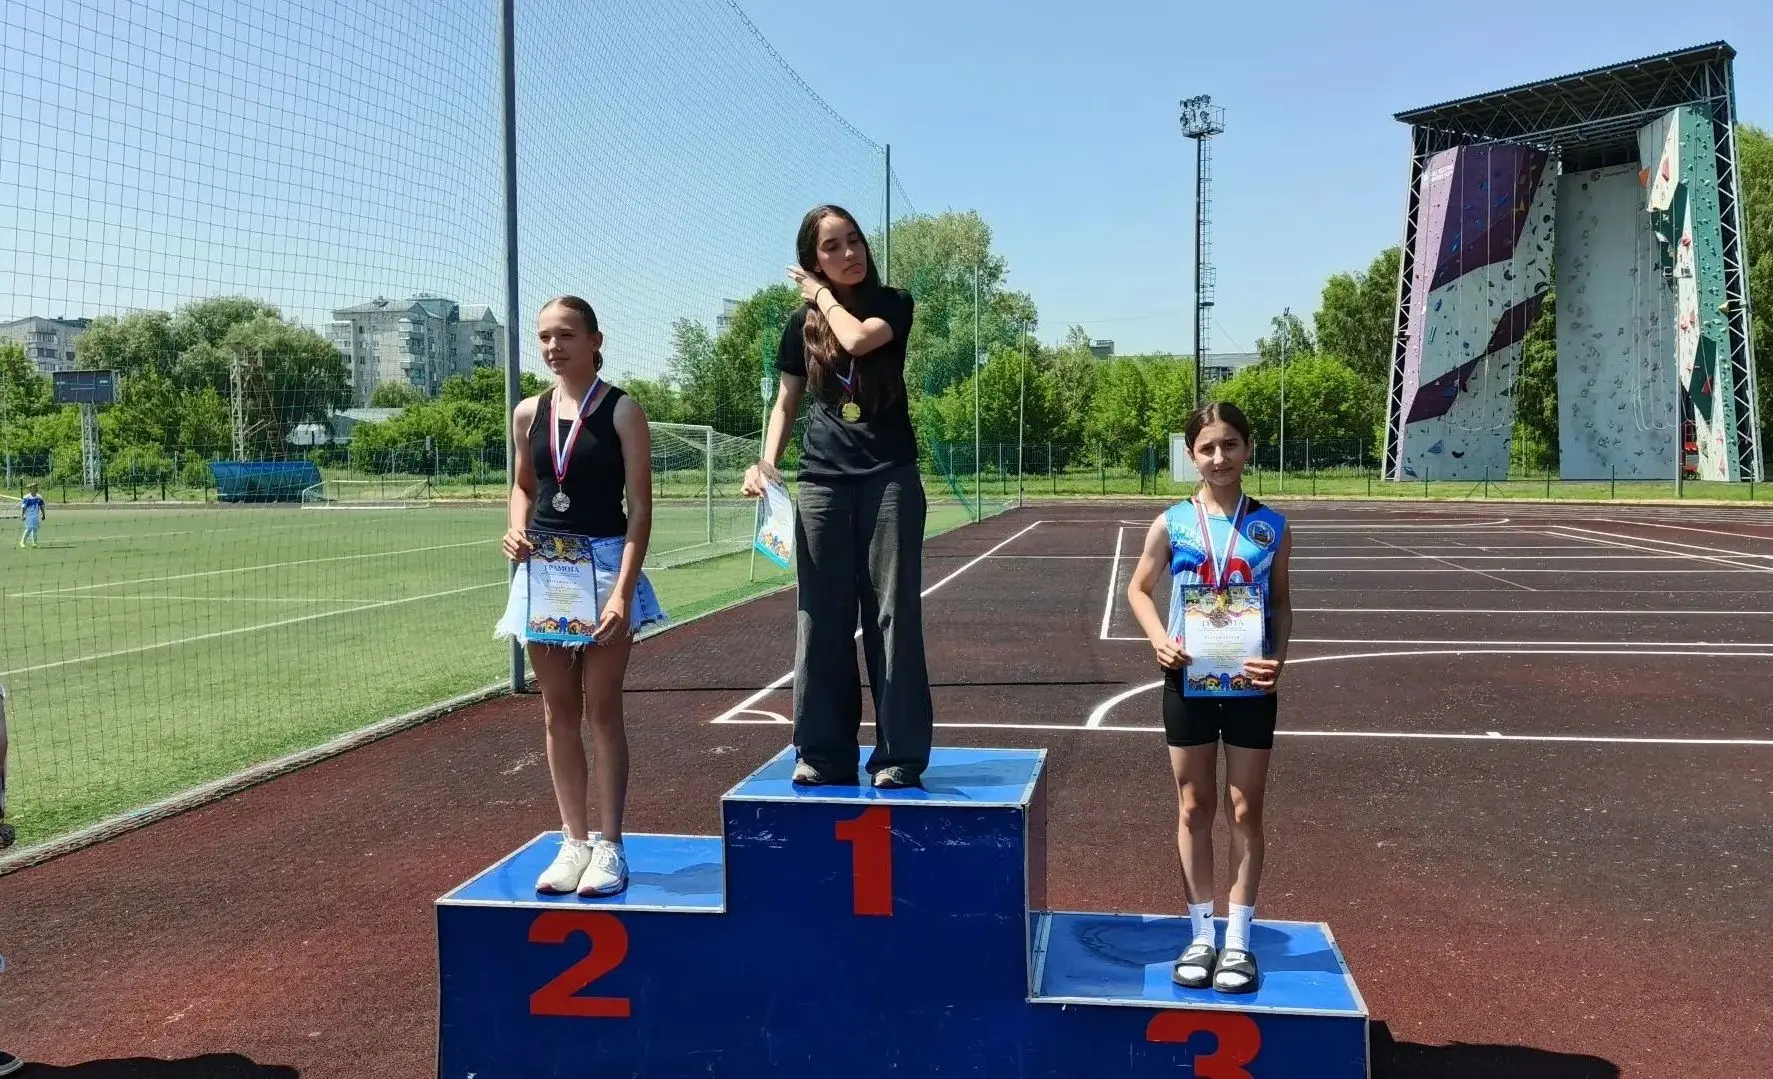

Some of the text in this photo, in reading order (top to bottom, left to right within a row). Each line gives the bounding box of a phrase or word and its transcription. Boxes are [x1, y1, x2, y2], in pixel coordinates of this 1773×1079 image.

[543, 564, 580, 574] ГРАМОТА
[835, 807, 892, 916] 1
[528, 911, 631, 1018] 2
[1227, 951, 1246, 959] NIKE
[1146, 1012, 1261, 1079] 3
